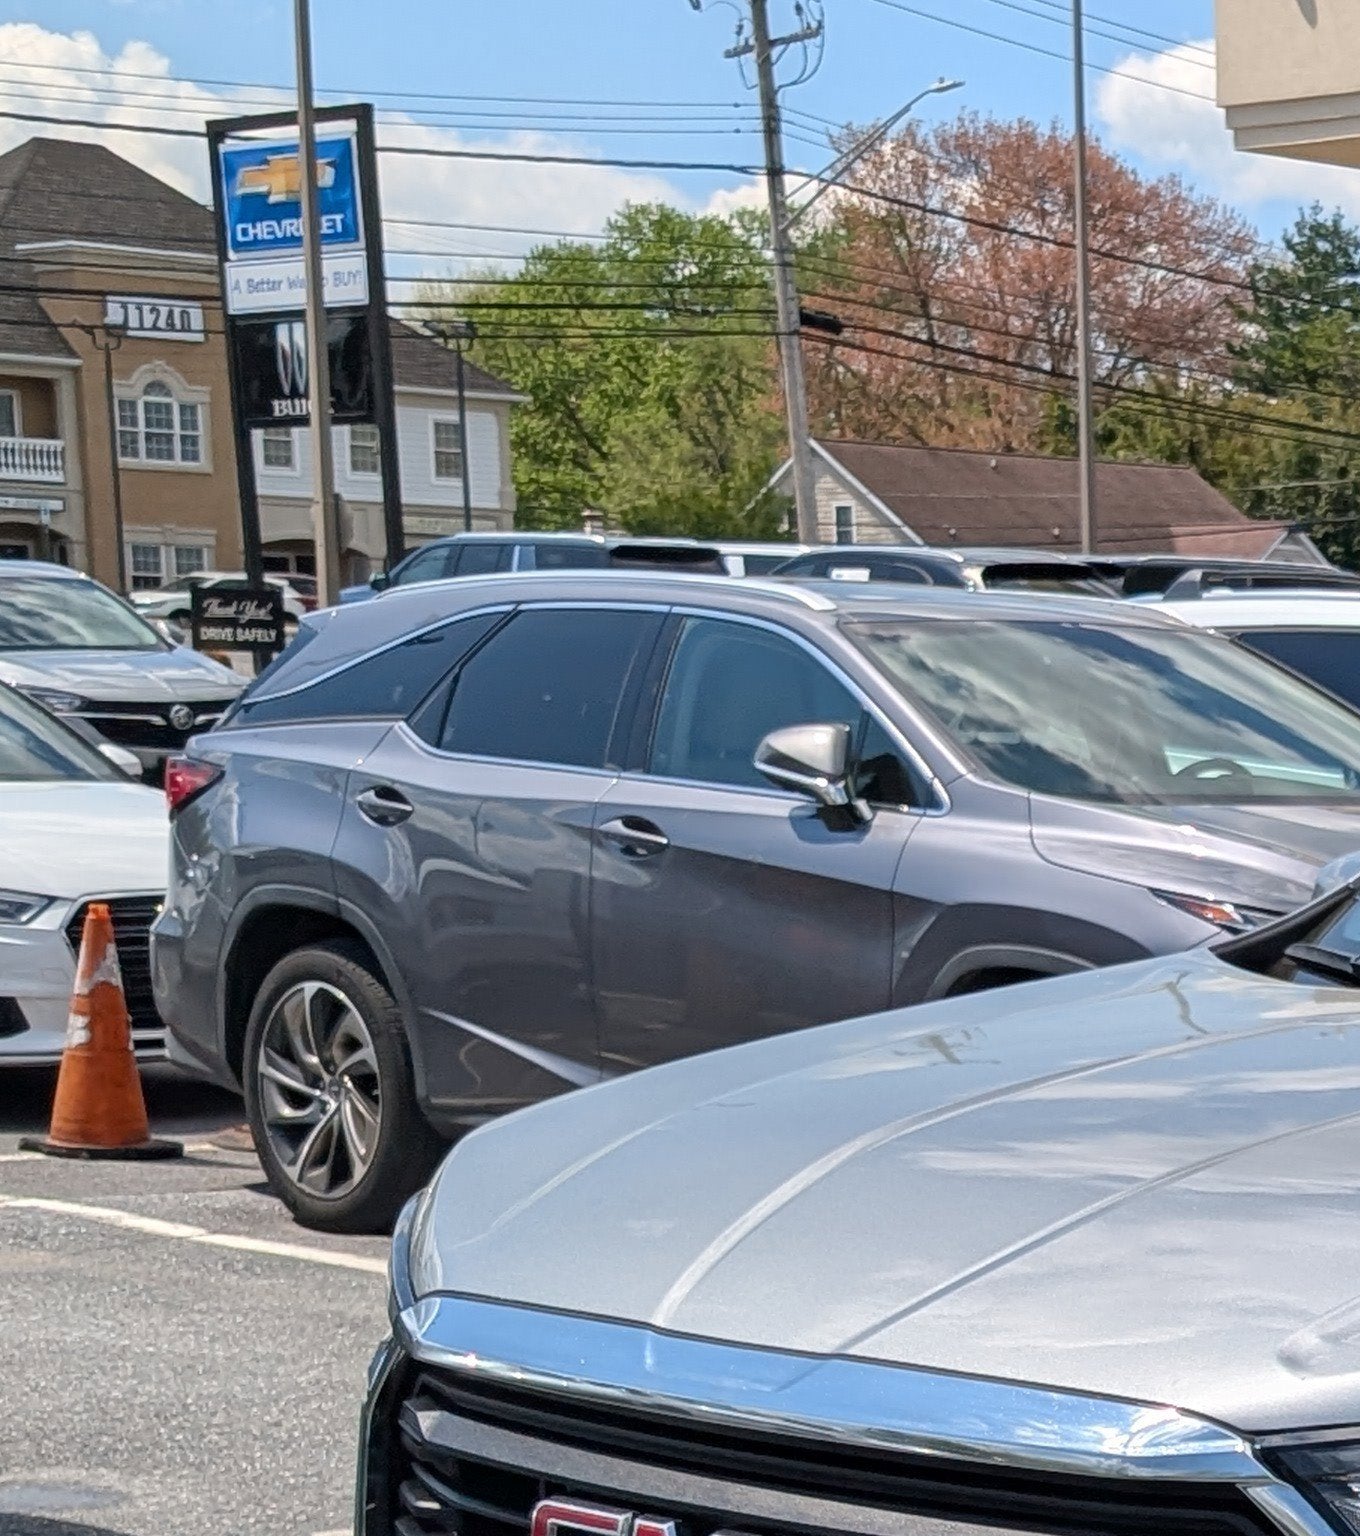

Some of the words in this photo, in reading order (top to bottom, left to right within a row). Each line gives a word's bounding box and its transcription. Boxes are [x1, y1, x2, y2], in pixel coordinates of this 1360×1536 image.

[236, 213, 344, 242] CHEVRET
[271, 398, 335, 417] BUI
[200, 626, 235, 642] DRIVE
[236, 627, 278, 643] SAFELY
